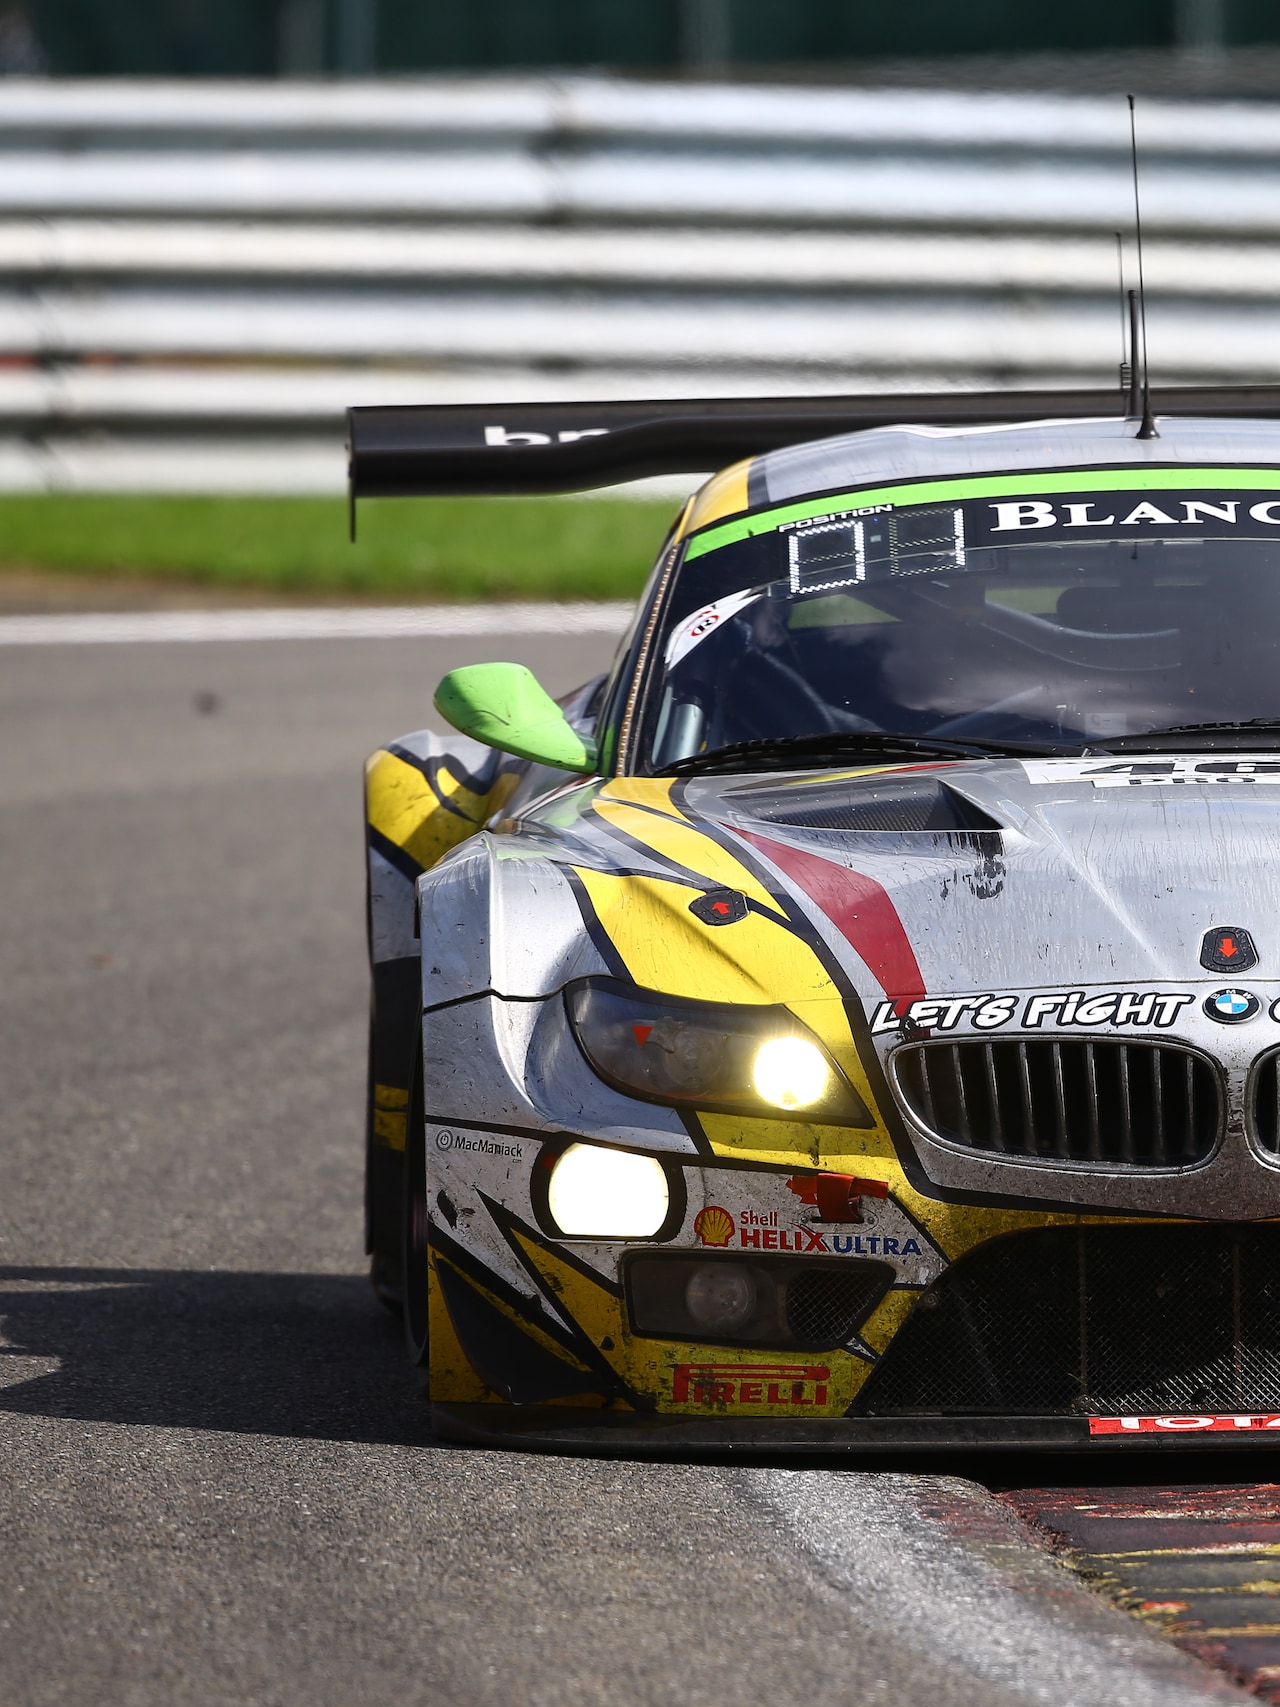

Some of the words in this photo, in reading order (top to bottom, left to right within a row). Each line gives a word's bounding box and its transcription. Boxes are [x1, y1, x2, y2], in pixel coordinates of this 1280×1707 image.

[779, 504, 893, 533] POSITION
[1129, 777, 1256, 785] PRO
[1210, 989, 1255, 1000] BMW
[872, 993, 1018, 1032] LET'S
[1020, 992, 1199, 1029] FIGHT
[454, 1136, 522, 1157] MacManiack
[740, 1210, 778, 1226] Shell
[740, 1222, 830, 1252] HELIX
[833, 1235, 922, 1256] ULTRA
[672, 1363, 831, 1405] PIRELLI
